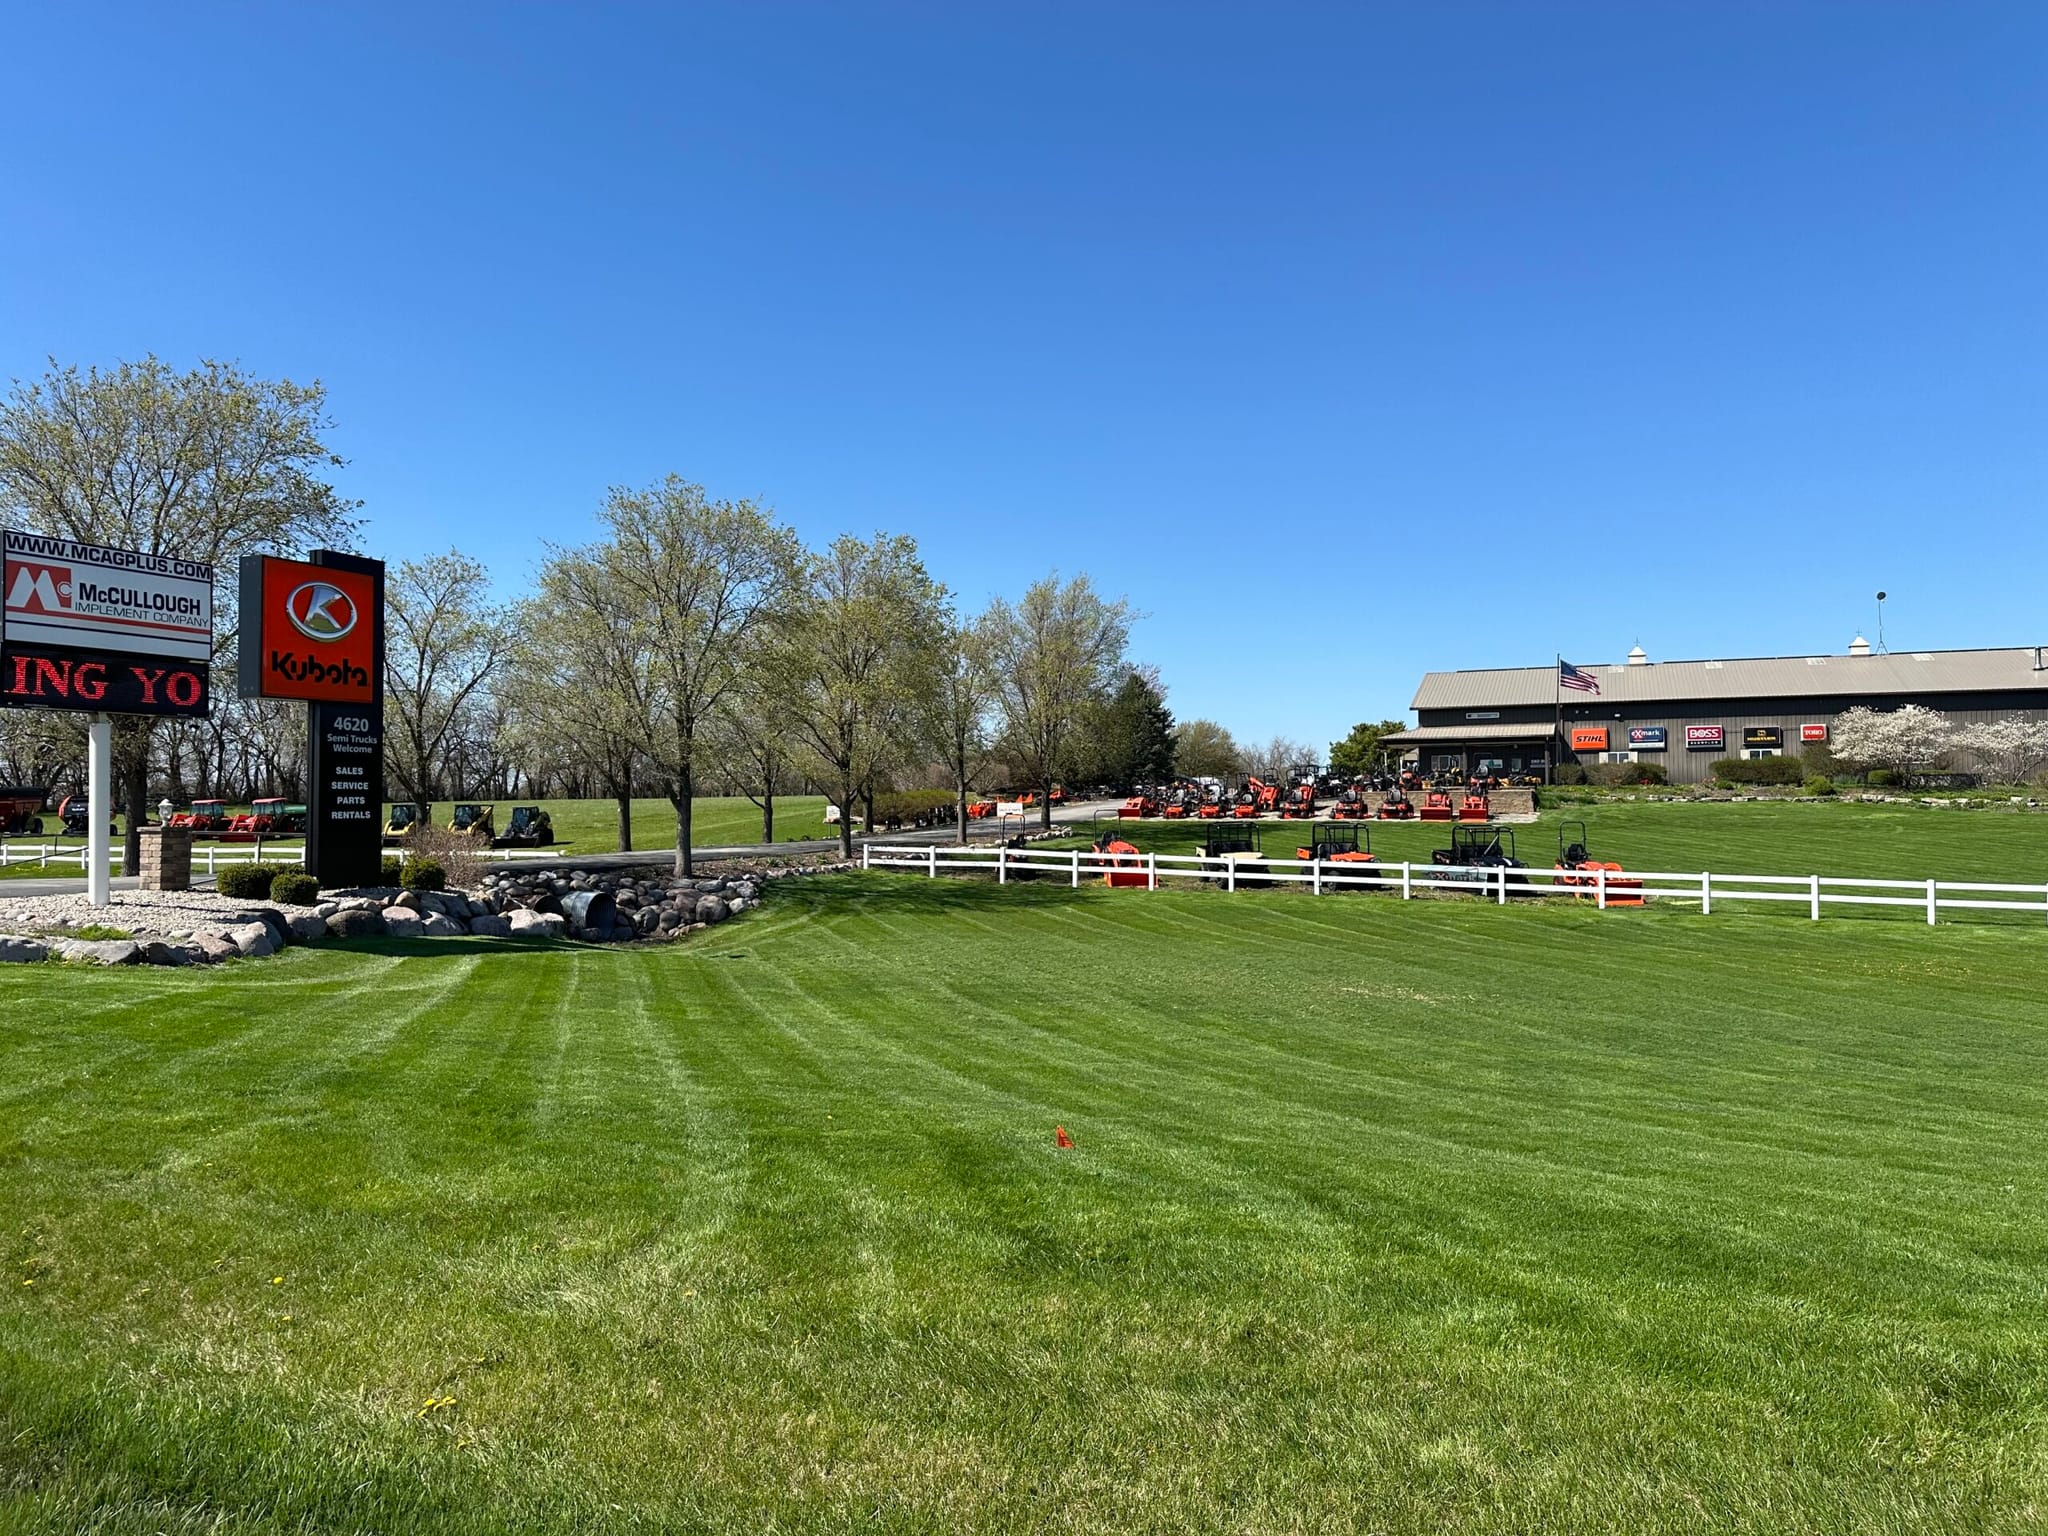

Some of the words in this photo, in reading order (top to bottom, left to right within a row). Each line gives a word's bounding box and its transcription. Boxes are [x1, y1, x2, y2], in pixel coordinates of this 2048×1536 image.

[6, 534, 210, 580] WWW.MCAGPLUS.COM
[79, 582, 201, 616] McCULLOUGH
[75, 601, 149, 620] IMPLEMENT
[153, 612, 209, 628] COMPANY
[271, 650, 368, 687] Kubota
[5, 656, 109, 699] ING
[129, 667, 201, 706] YO
[333, 716, 369, 732] 4620
[327, 733, 349, 743] Semi
[351, 734, 378, 744] Trucks
[1689, 729, 1719, 738] BOSS
[333, 744, 373, 753] Welcome
[335, 766, 364, 775] SALES
[331, 781, 369, 790] SERVICE
[336, 796, 366, 805] PARTS
[331, 811, 371, 819] RENTALS
